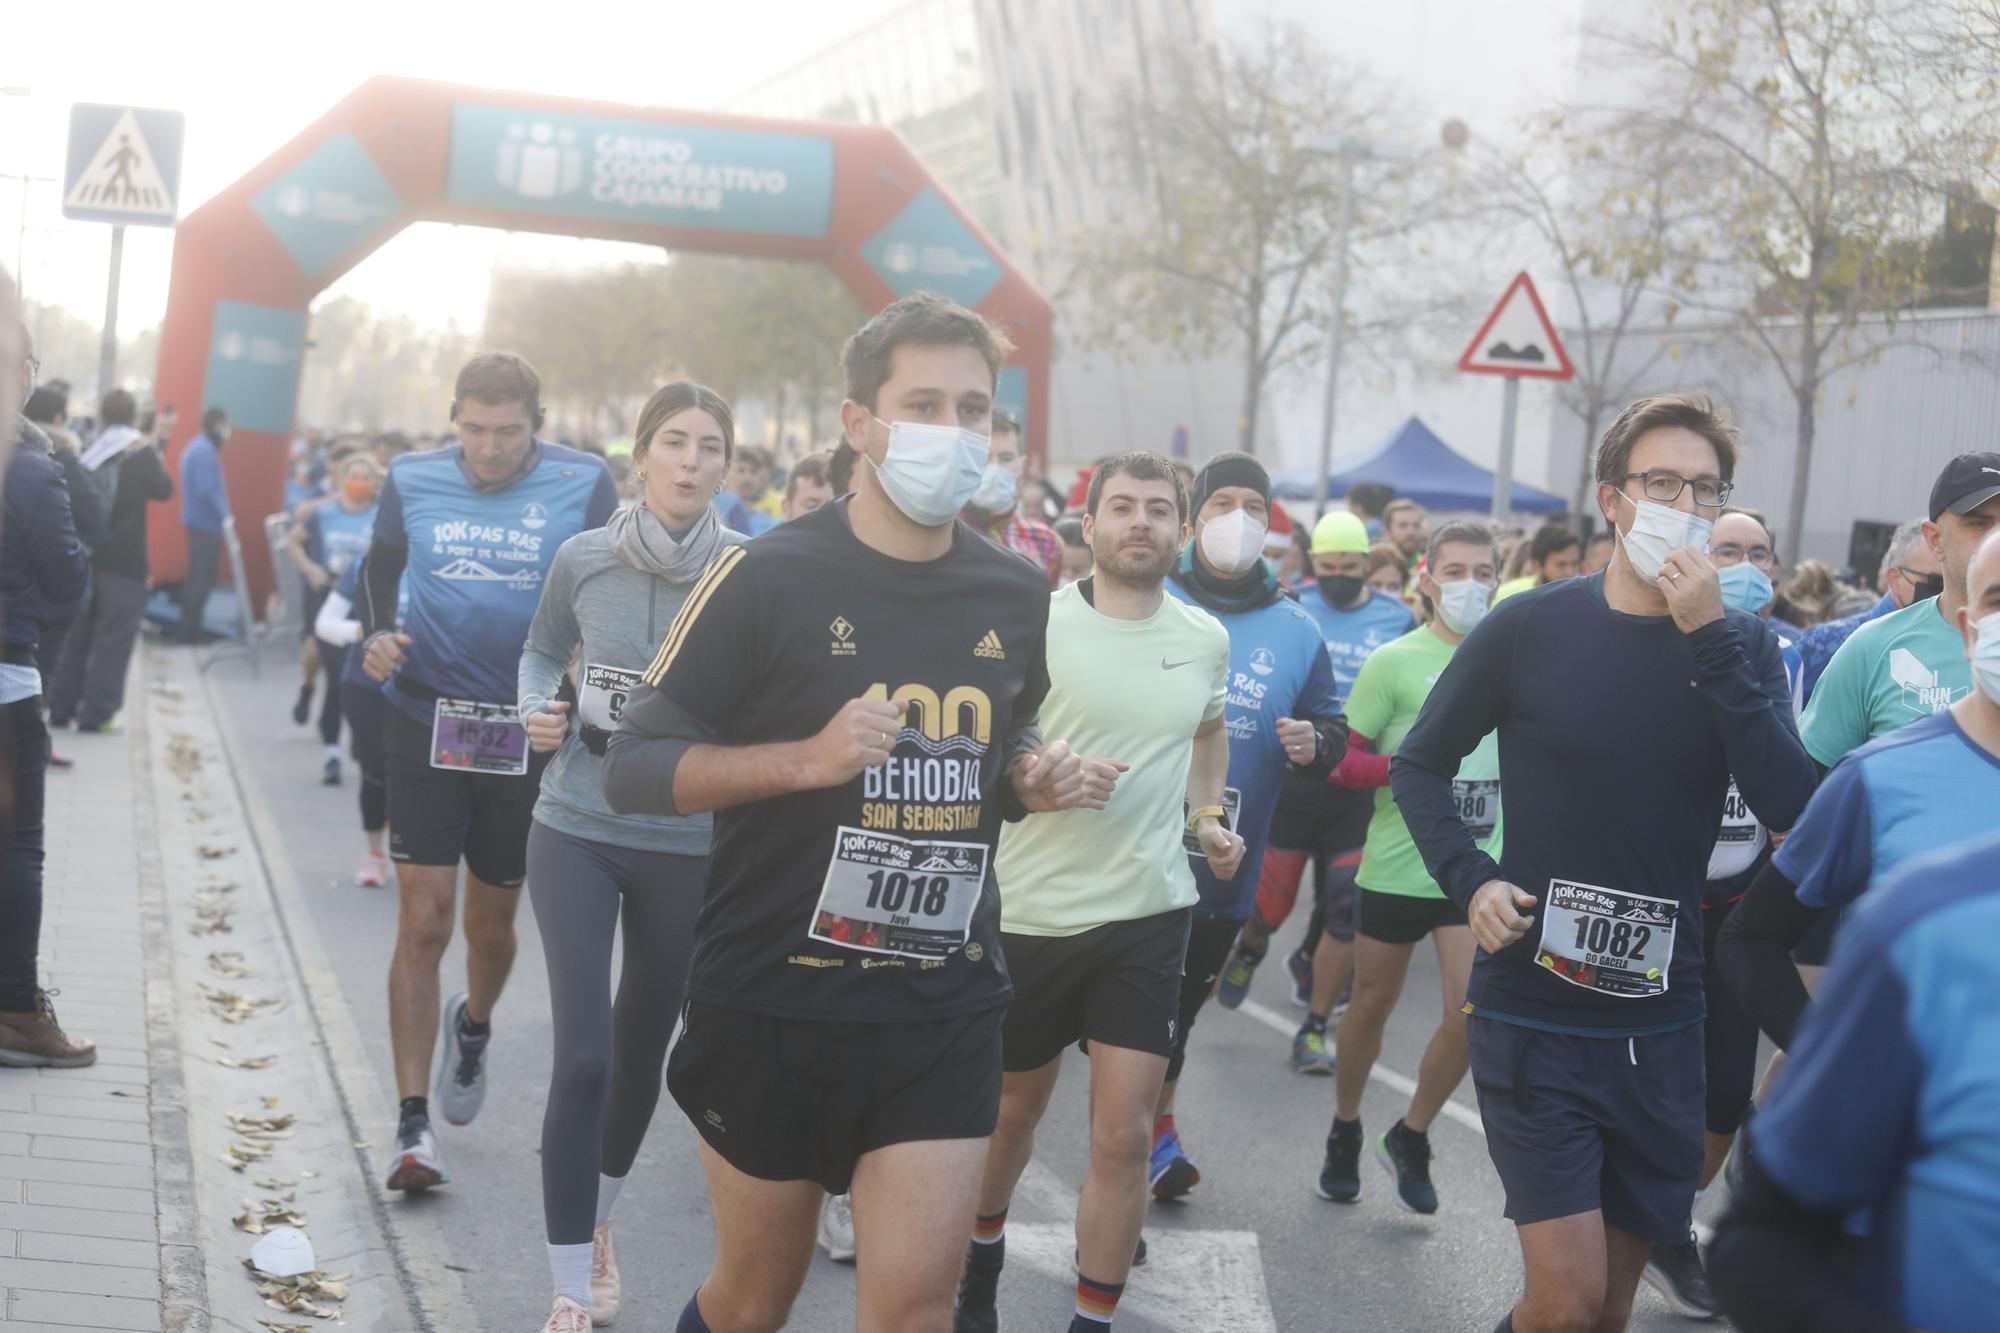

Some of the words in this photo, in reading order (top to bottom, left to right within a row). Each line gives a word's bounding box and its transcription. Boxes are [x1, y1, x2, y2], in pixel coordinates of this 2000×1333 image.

[594, 134, 692, 163] GRUPO
[593, 157, 787, 195] COOPERATIVO
[590, 181, 723, 213] CAJAMAR
[433, 520, 469, 543] 10K
[469, 525, 505, 543] PAS
[508, 530, 543, 552] RAS
[973, 647, 1006, 660] adidas
[589, 668, 604, 679] 10K
[604, 671, 619, 681] PAS
[620, 675, 635, 687] RAS
[1233, 672, 1268, 700] RAS
[1919, 687, 1952, 705] RUN
[457, 720, 510, 749] 1532
[864, 756, 982, 803] BEHOBIA
[862, 802, 898, 830] SAN
[841, 851, 849, 860] AL
[850, 853, 869, 862] PORT
[870, 855, 880, 864] DE
[842, 835, 868, 851] 10K
[867, 841, 890, 853] PAS
[889, 844, 913, 861] RAS
[866, 869, 950, 917] 1018
[1554, 886, 1576, 899] 10K
[1575, 890, 1597, 901] PAS
[1597, 895, 1617, 909] RAS
[1579, 903, 1588, 911] DE
[890, 913, 911, 926] Javi
[1574, 915, 1651, 961] 1082
[1585, 952, 1597, 964] GO
[1600, 955, 1628, 970] GACELA
